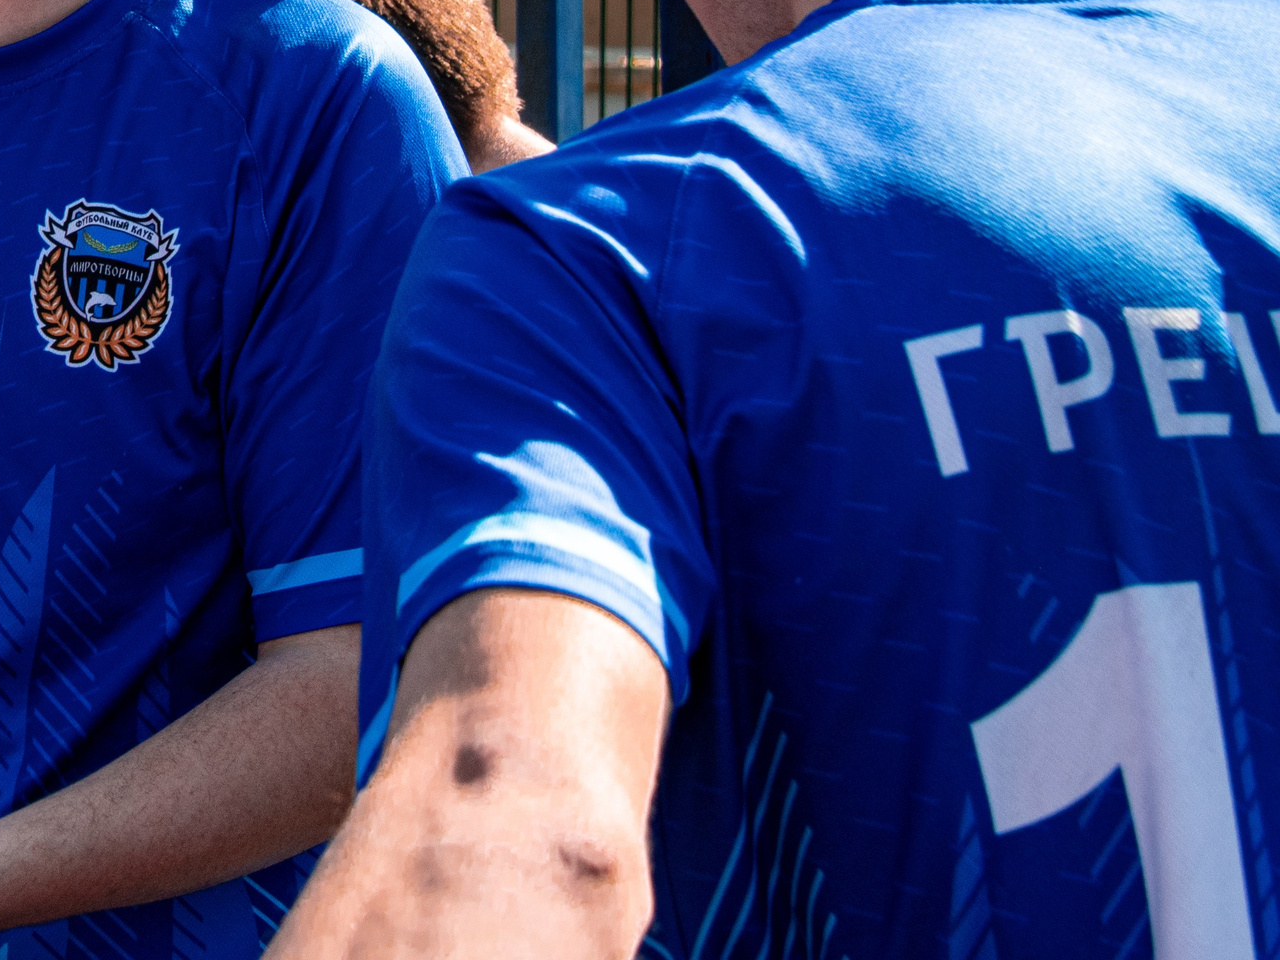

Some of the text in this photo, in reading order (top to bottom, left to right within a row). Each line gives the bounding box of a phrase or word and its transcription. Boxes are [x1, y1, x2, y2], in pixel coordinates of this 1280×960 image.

[75, 214, 154, 241] ФУТБОЛЬНЫЙ КЛУБ
[70, 261, 144, 283] МИРОТВОРЦЫ
[970, 581, 1258, 960] 1
